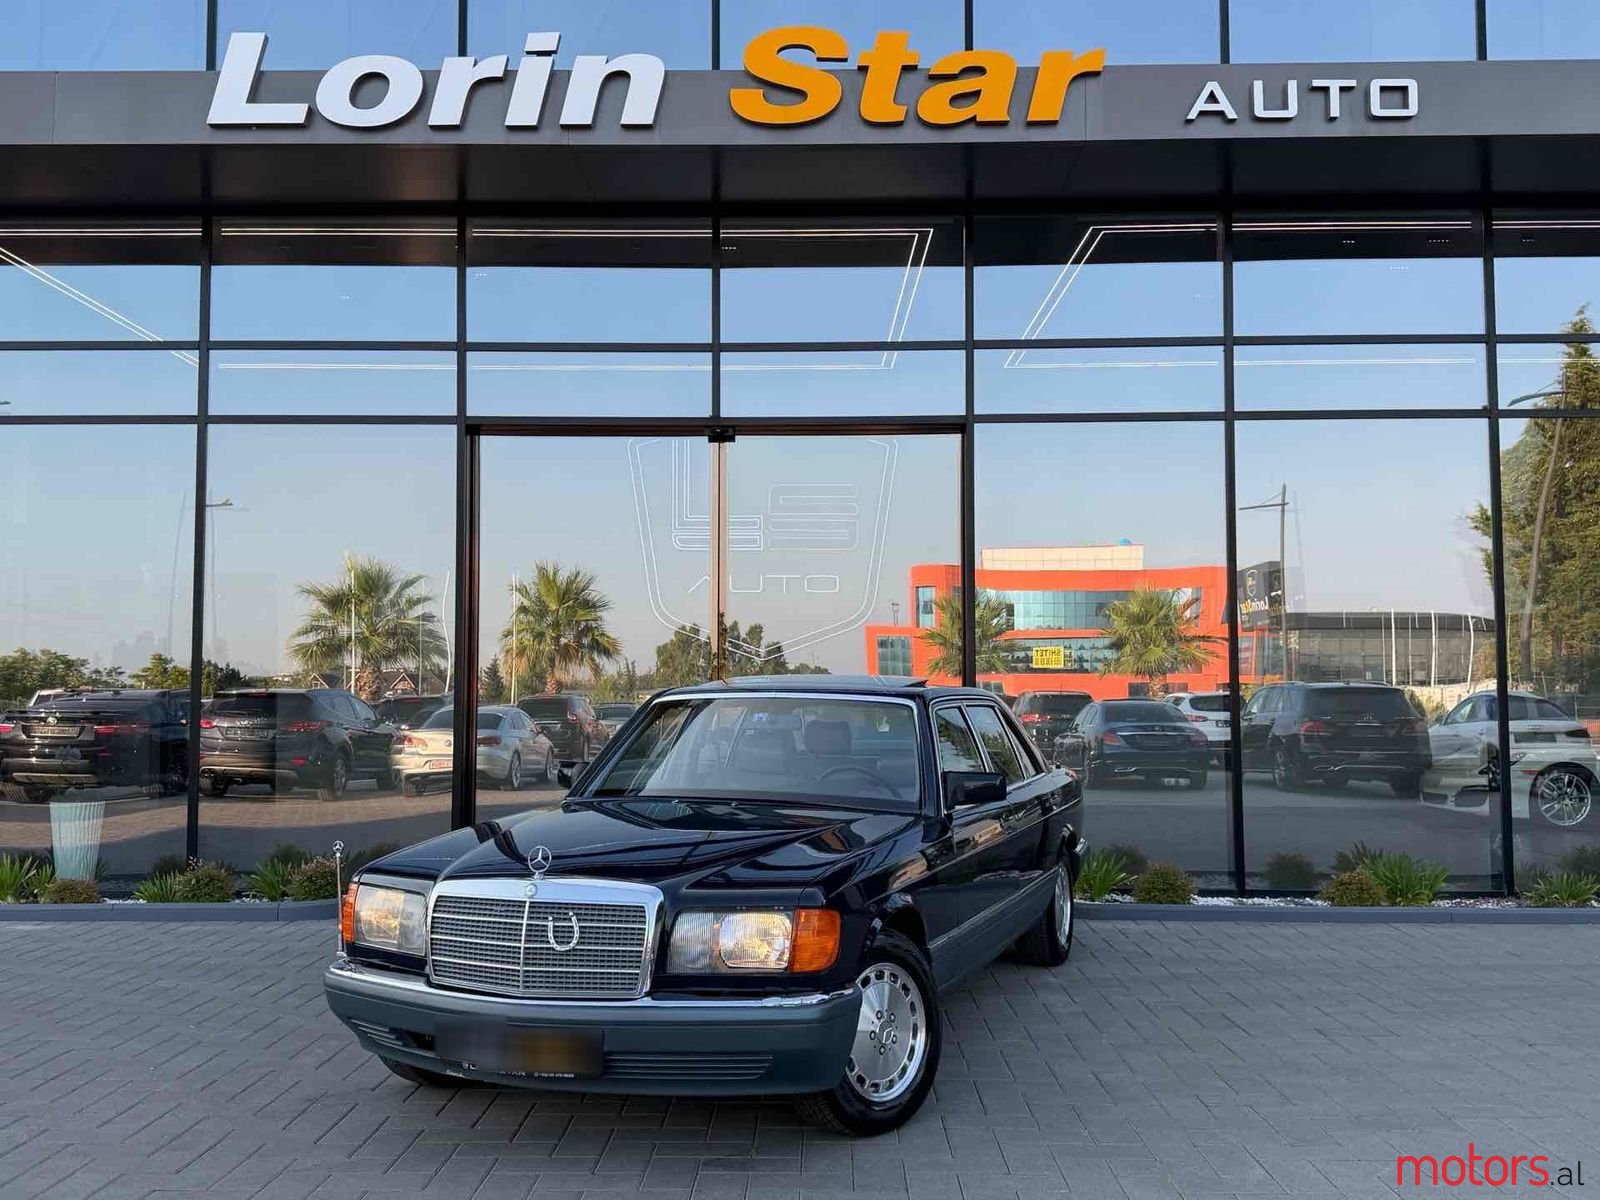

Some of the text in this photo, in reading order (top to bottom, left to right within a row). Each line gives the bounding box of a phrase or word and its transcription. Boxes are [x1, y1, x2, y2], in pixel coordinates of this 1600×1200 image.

[207, 25, 1420, 128] Lorin Star AUTO
